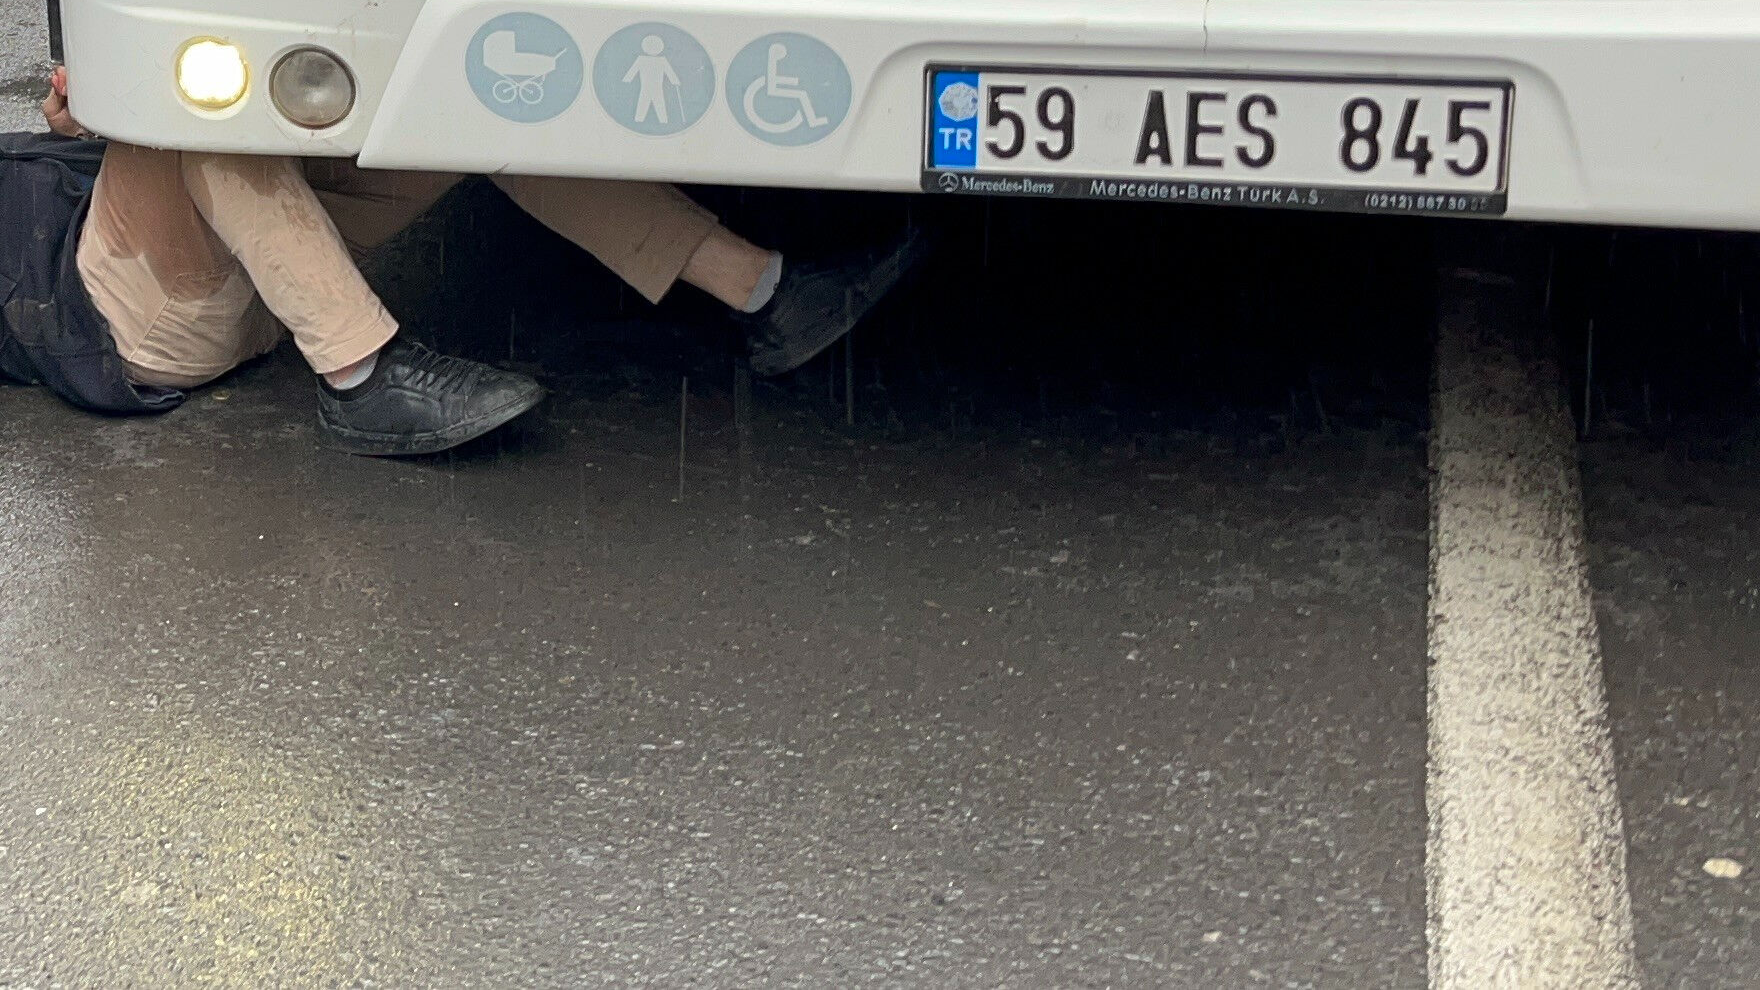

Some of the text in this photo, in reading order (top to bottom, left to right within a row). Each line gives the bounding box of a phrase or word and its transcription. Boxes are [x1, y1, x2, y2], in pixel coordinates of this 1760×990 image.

[938, 127, 972, 151] TR
[984, 85, 1492, 178] 59 AES 845
[961, 175, 1055, 194] Mercedes-Benz
[1089, 179, 1232, 201] Mercedes-Benz
